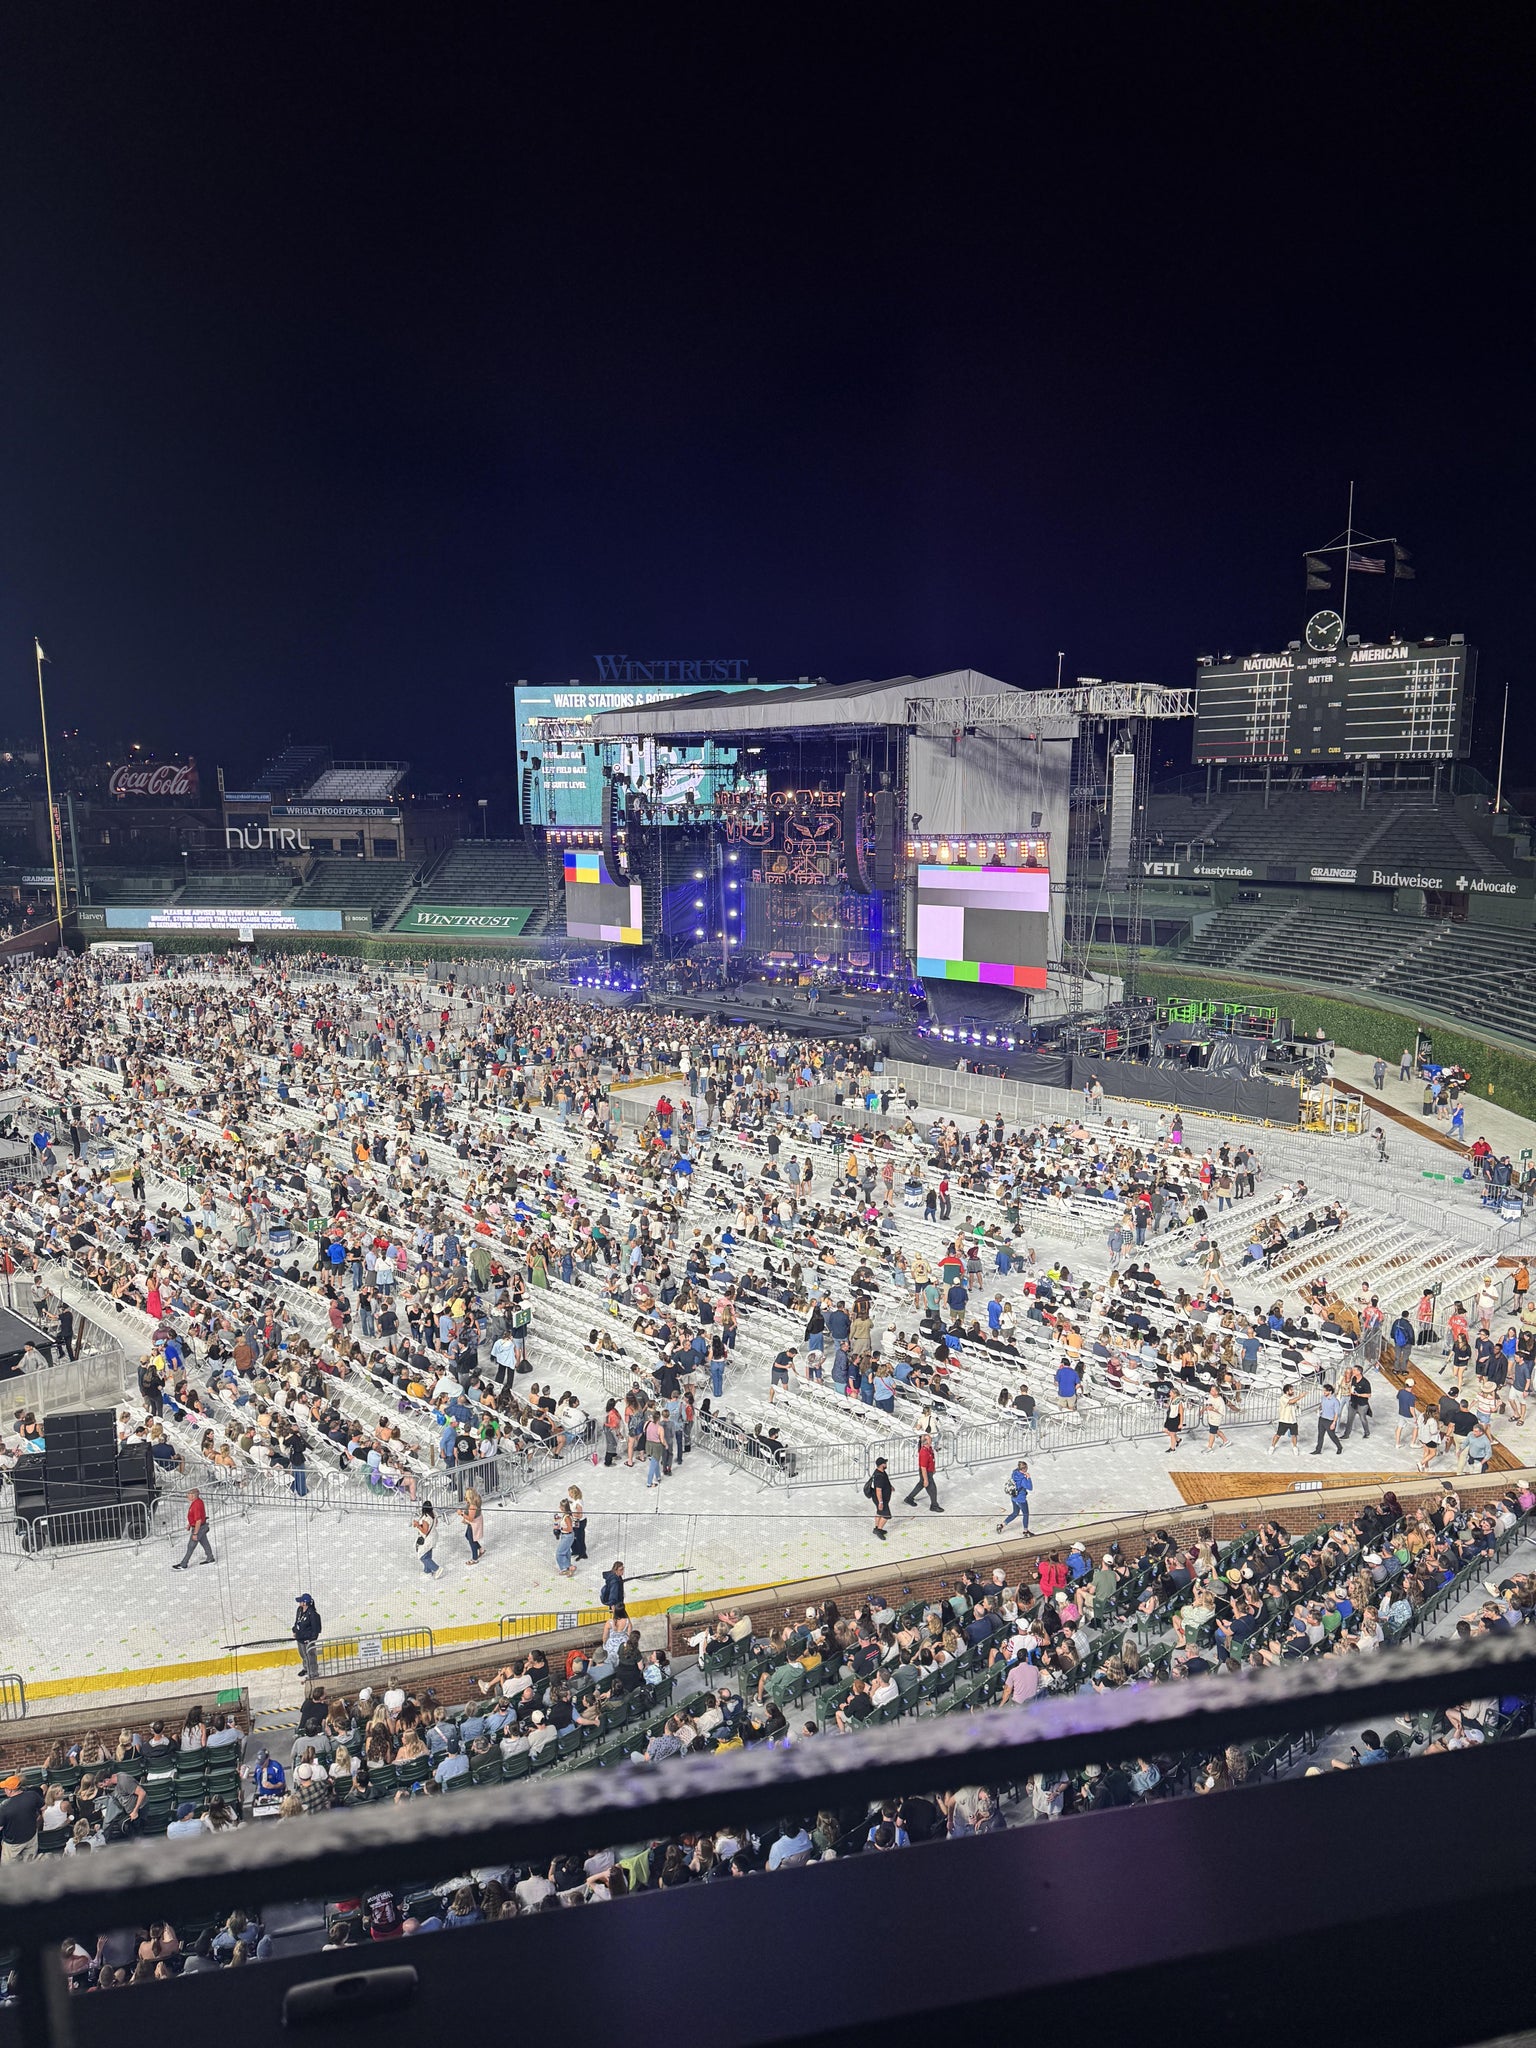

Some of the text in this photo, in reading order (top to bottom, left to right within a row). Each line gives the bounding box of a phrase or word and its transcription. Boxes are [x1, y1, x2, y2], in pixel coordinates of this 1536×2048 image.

[1307, 656, 1337, 665] UMPIRES
[1350, 647, 1408, 662] AMERICAN
[593, 655, 748, 682] WINTRUST
[1243, 656, 1294, 671] NATIONAL
[1308, 674, 1334, 684] BATTER
[553, 693, 587, 708] WATER
[588, 693, 634, 708] STATIONS
[636, 693, 644, 706] &
[571, 751, 585, 759] GAT
[541, 766, 587, 774] LEFT FIELD GATE
[109, 765, 193, 795] Coca-Cola
[286, 807, 384, 816] WRIGLEYROOFTOPS.COM
[1143, 863, 1179, 876] YETI
[1201, 866, 1253, 878] tastytrade
[1310, 867, 1357, 878] GRAINGER
[1469, 880, 1517, 893] Advocate
[79, 912, 104, 921] Harvey
[417, 912, 516, 926] WINTRUST
[7, 951, 34, 968] YETI
